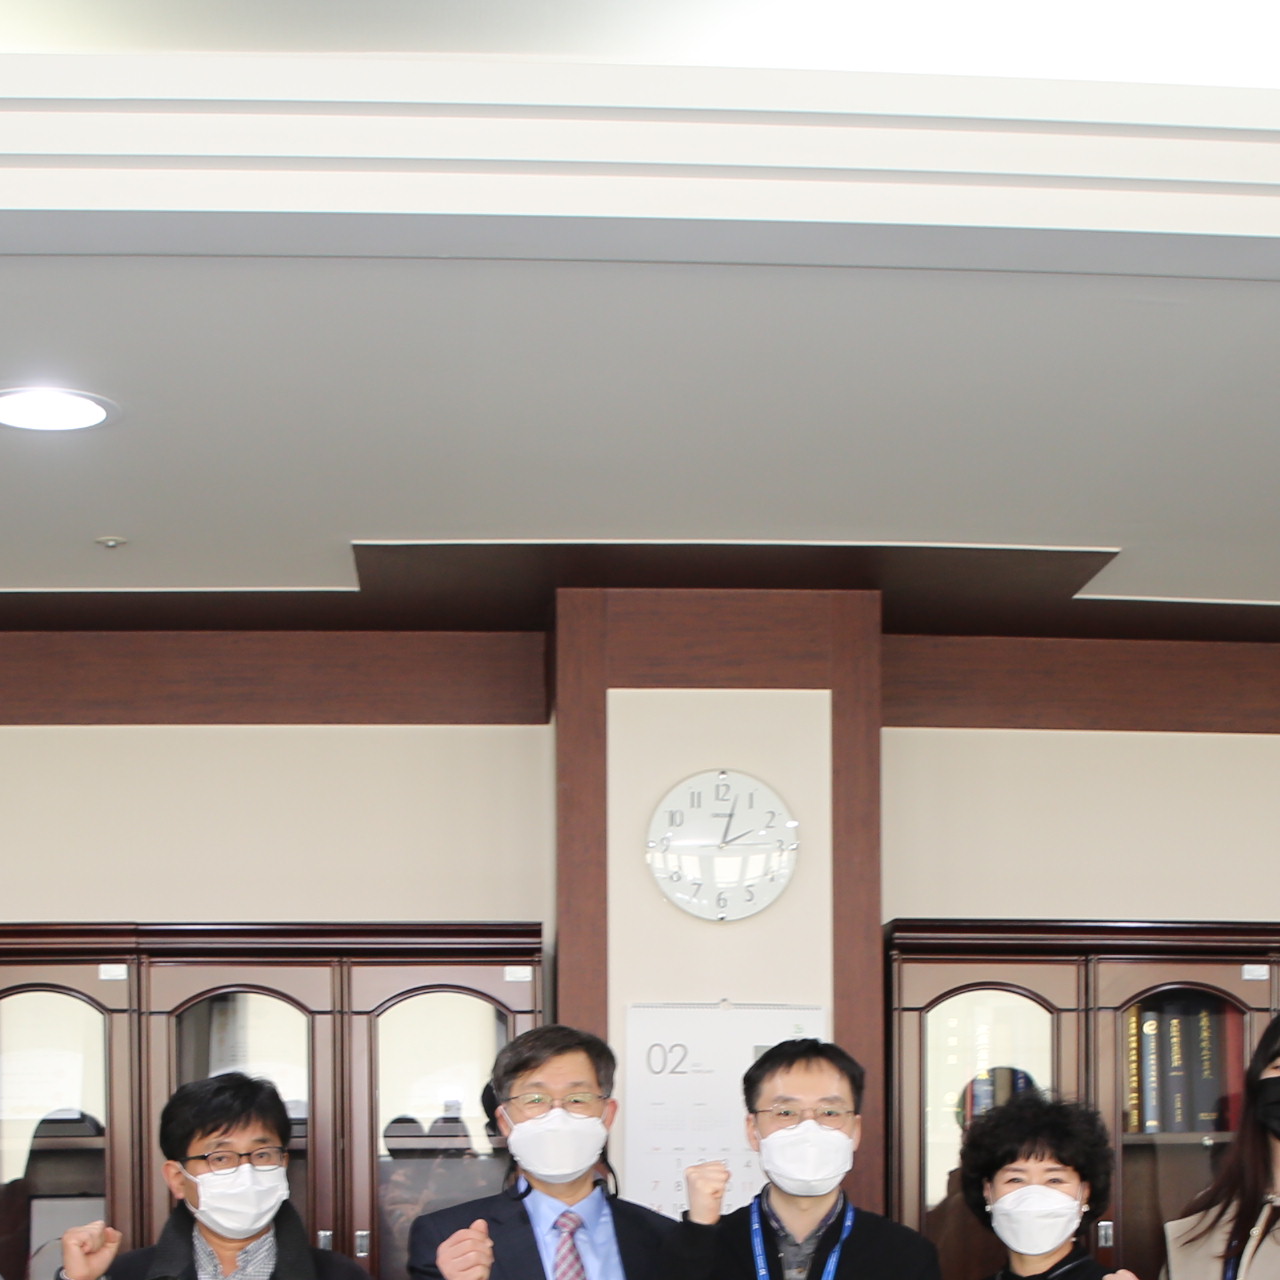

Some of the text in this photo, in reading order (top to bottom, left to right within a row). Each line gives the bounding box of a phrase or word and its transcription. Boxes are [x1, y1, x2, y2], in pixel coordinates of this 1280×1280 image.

[689, 791, 702, 809] 11
[714, 783, 731, 802] 12
[748, 792, 754, 810] 1
[667, 809, 684, 827] 10
[765, 810, 776, 829] 2
[660, 836, 670, 854] 9
[776, 839, 785, 856] 3
[691, 882, 703, 898] 7
[745, 884, 755, 902] 5
[716, 891, 728, 909] 6
[647, 1043, 688, 1075] 02
